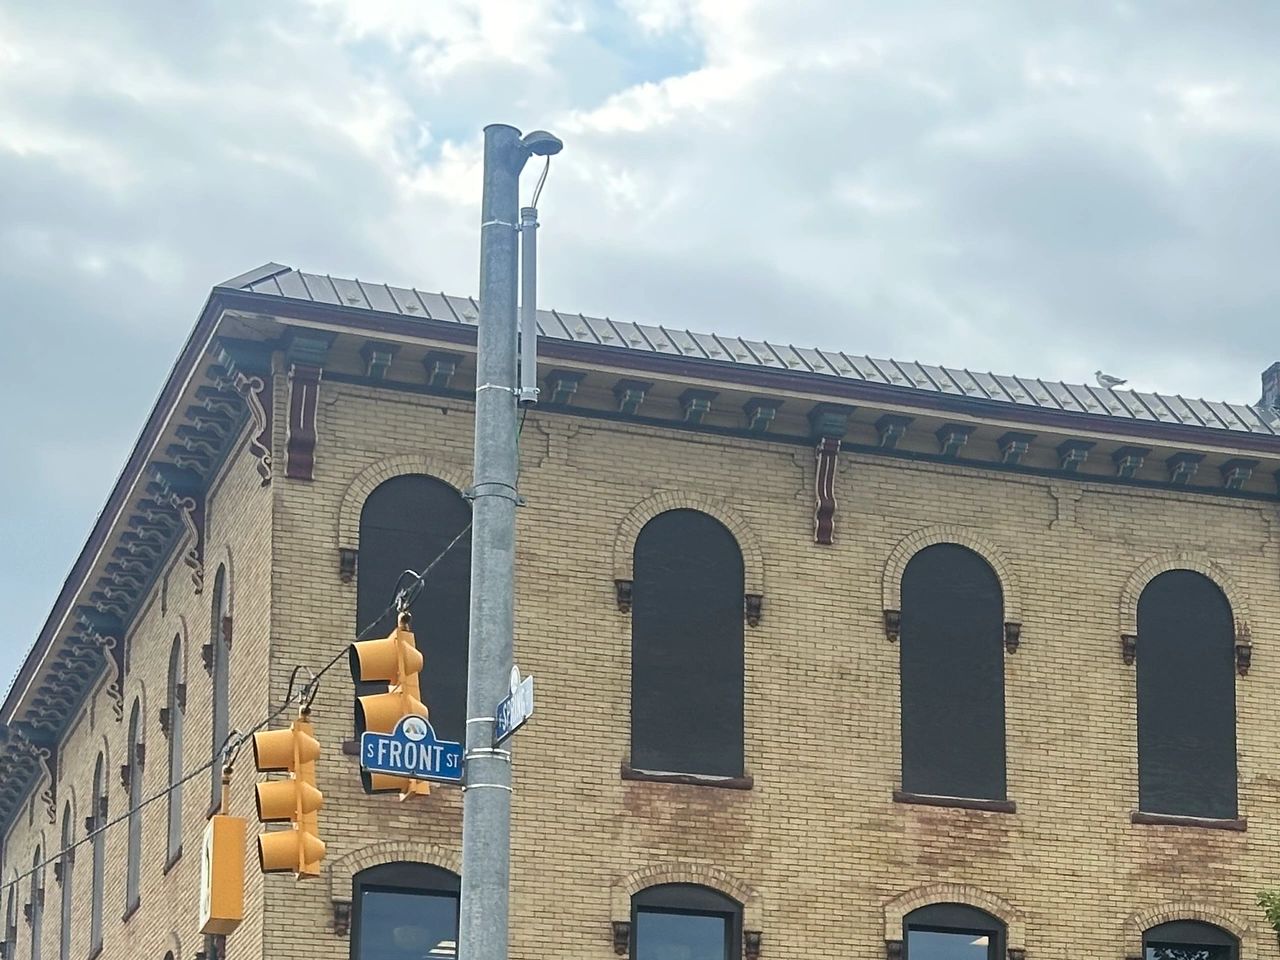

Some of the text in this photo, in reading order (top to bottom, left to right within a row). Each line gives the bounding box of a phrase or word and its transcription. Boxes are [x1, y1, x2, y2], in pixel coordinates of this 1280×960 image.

[367, 738, 459, 773] S FRONT ST
